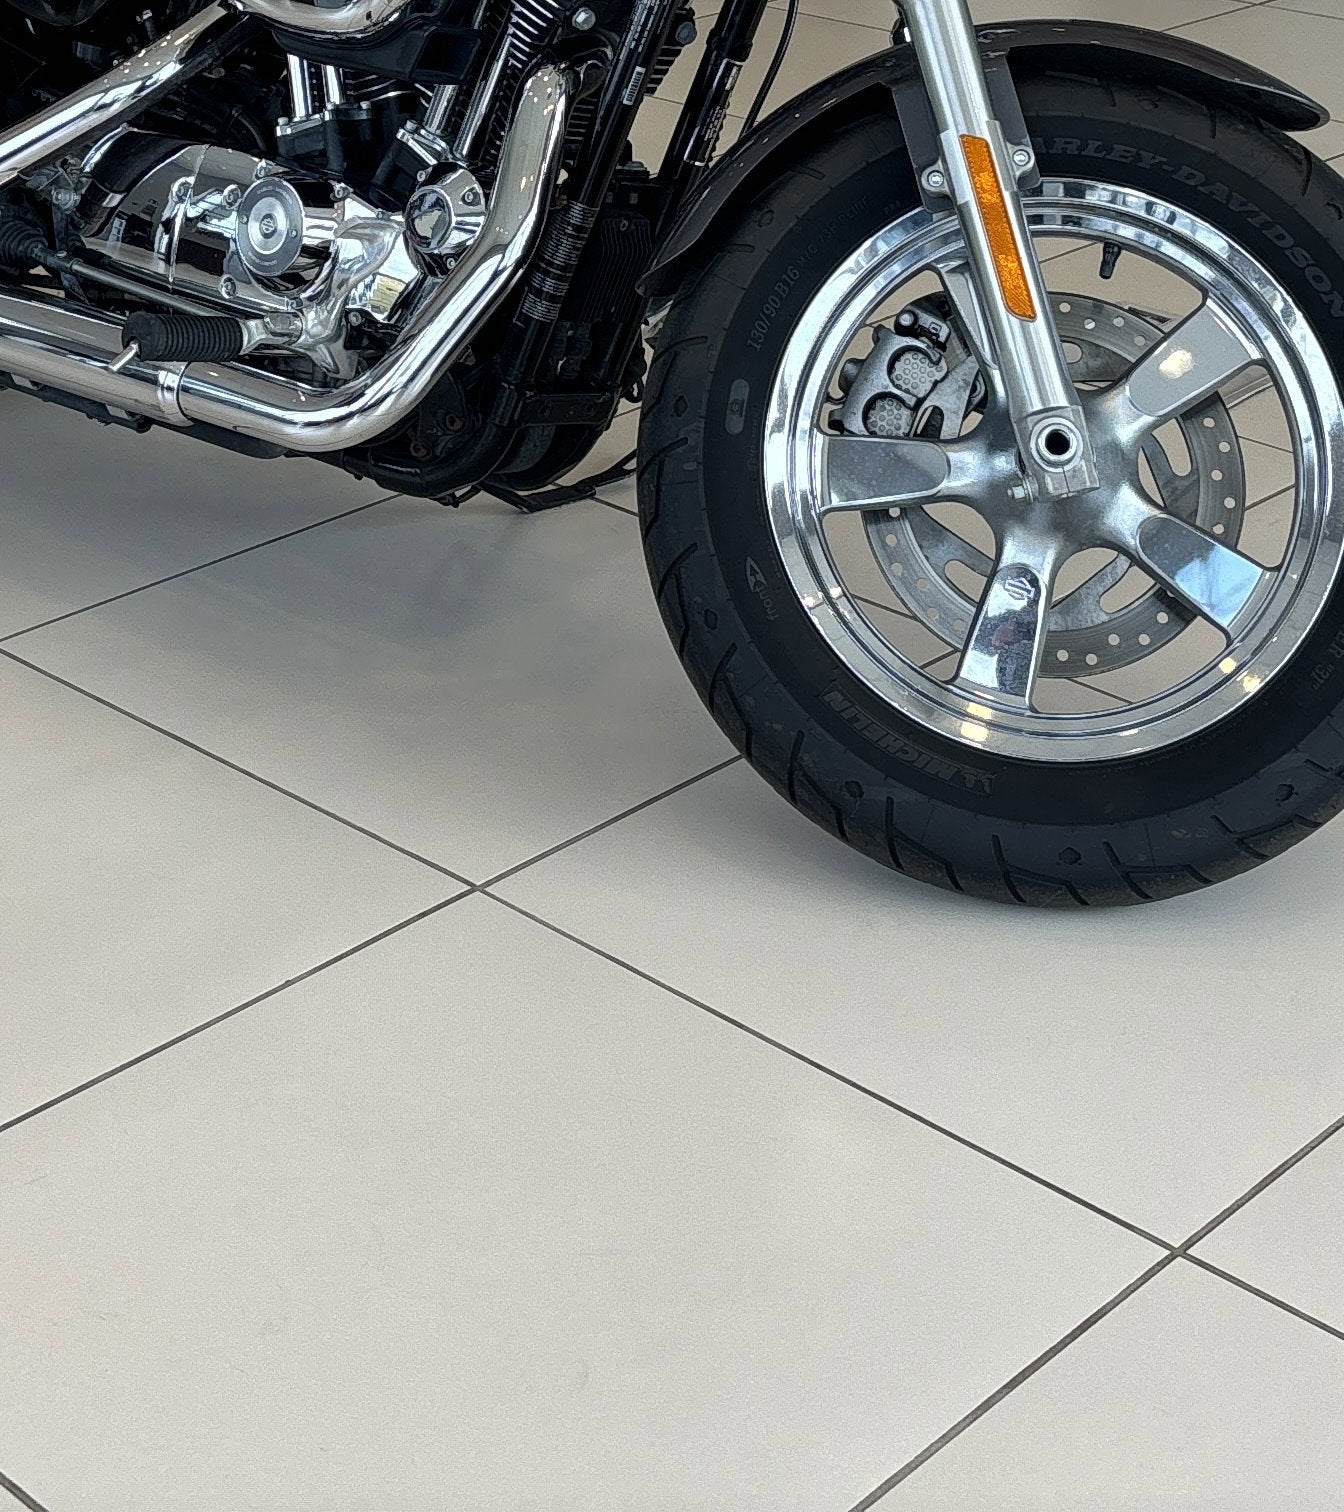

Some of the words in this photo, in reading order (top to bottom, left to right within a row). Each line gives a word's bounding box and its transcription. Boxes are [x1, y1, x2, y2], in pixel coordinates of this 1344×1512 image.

[744, 292, 785, 352] 130/90
[771, 264, 803, 298] B16
[752, 581, 780, 622] front
[1303, 656, 1336, 692] "31"
[820, 687, 959, 782] MICHELIN
